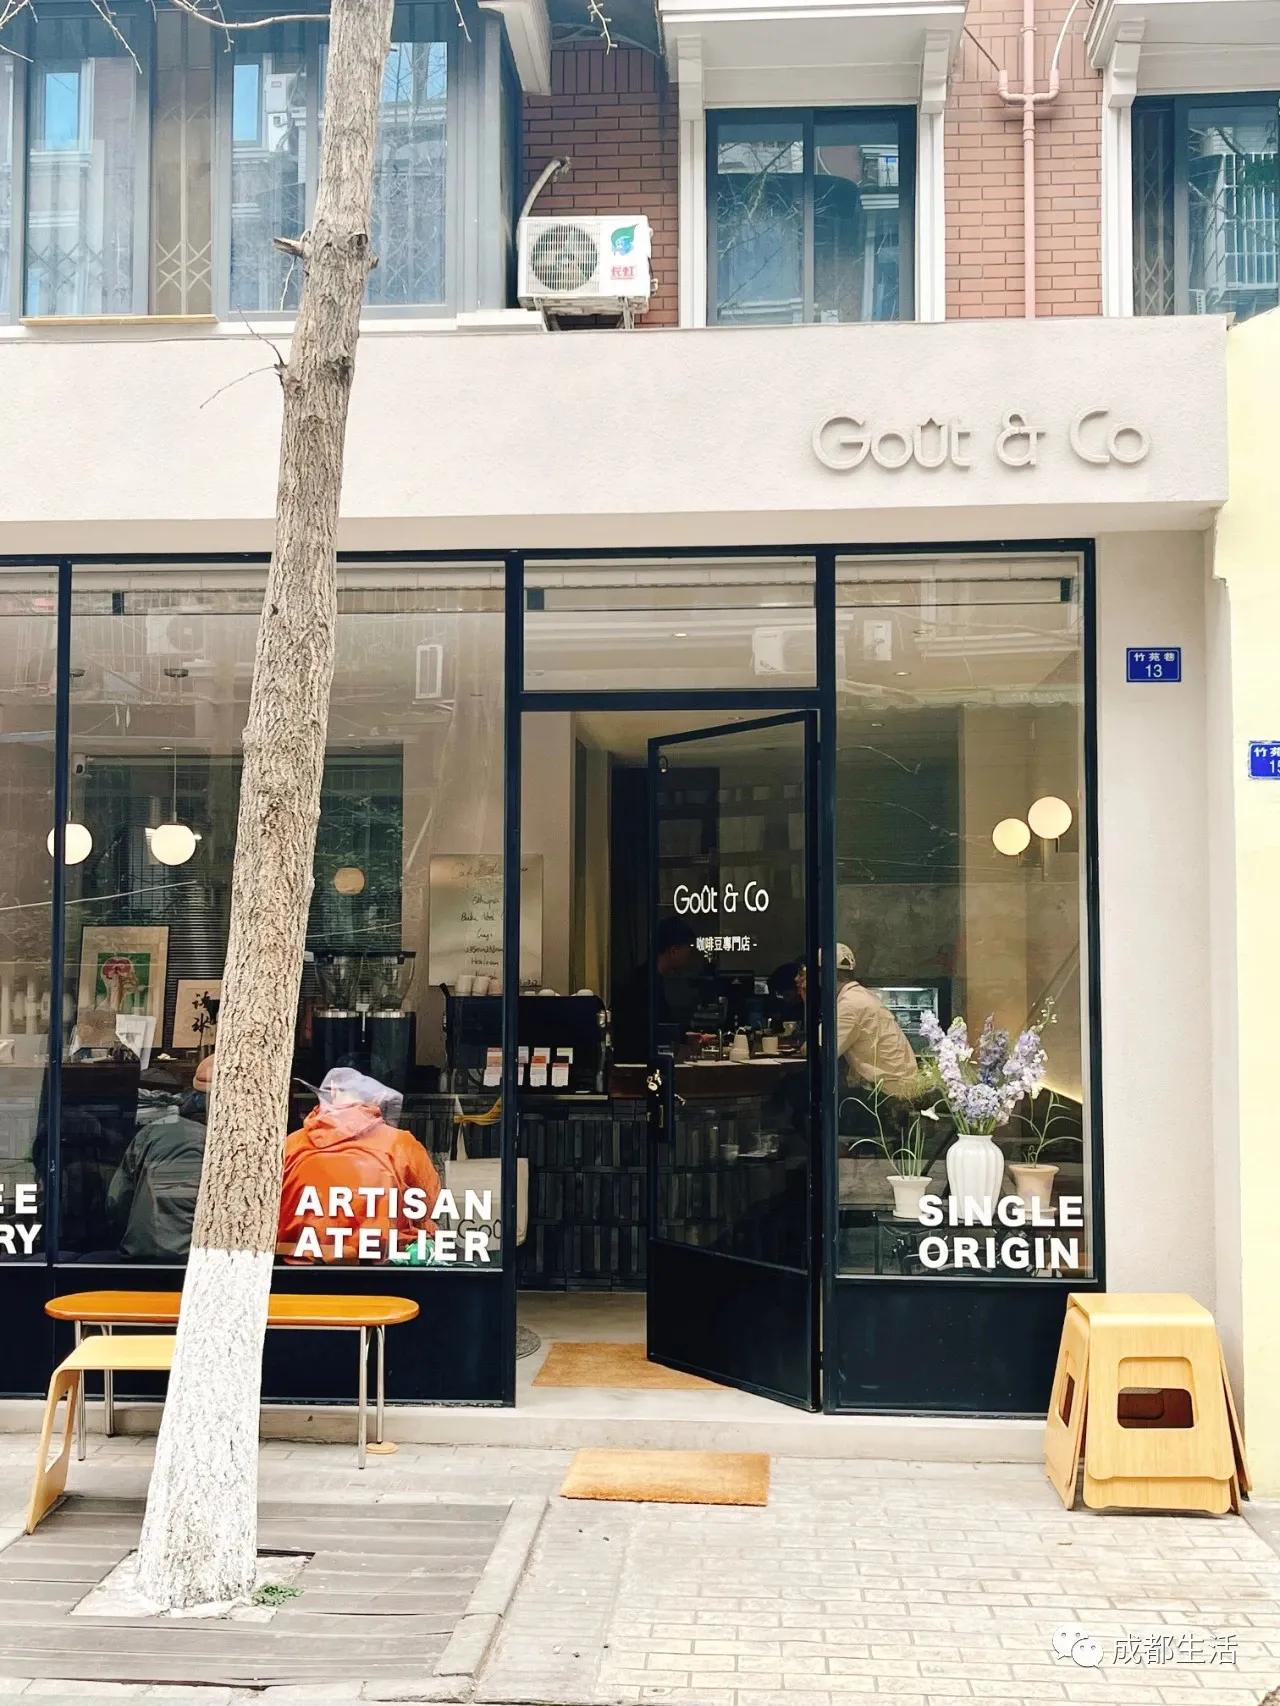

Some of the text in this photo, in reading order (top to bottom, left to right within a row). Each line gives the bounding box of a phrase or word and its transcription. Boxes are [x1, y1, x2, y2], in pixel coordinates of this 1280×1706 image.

[997, 408, 1046, 468] &
[1070, 405, 1152, 465] Co
[1133, 652, 1175, 662] 竹苑巷
[1145, 664, 1163, 678] 13
[723, 883, 739, 913] &
[744, 881, 769, 912] Co
[0, 1184, 38, 1214] E
[294, 1186, 492, 1220] ARTISAN
[918, 1194, 1084, 1227] SINGLE
[0, 1224, 42, 1254] RY
[293, 1226, 491, 1262] ATELIER
[918, 1236, 1079, 1269] ORIGIN
